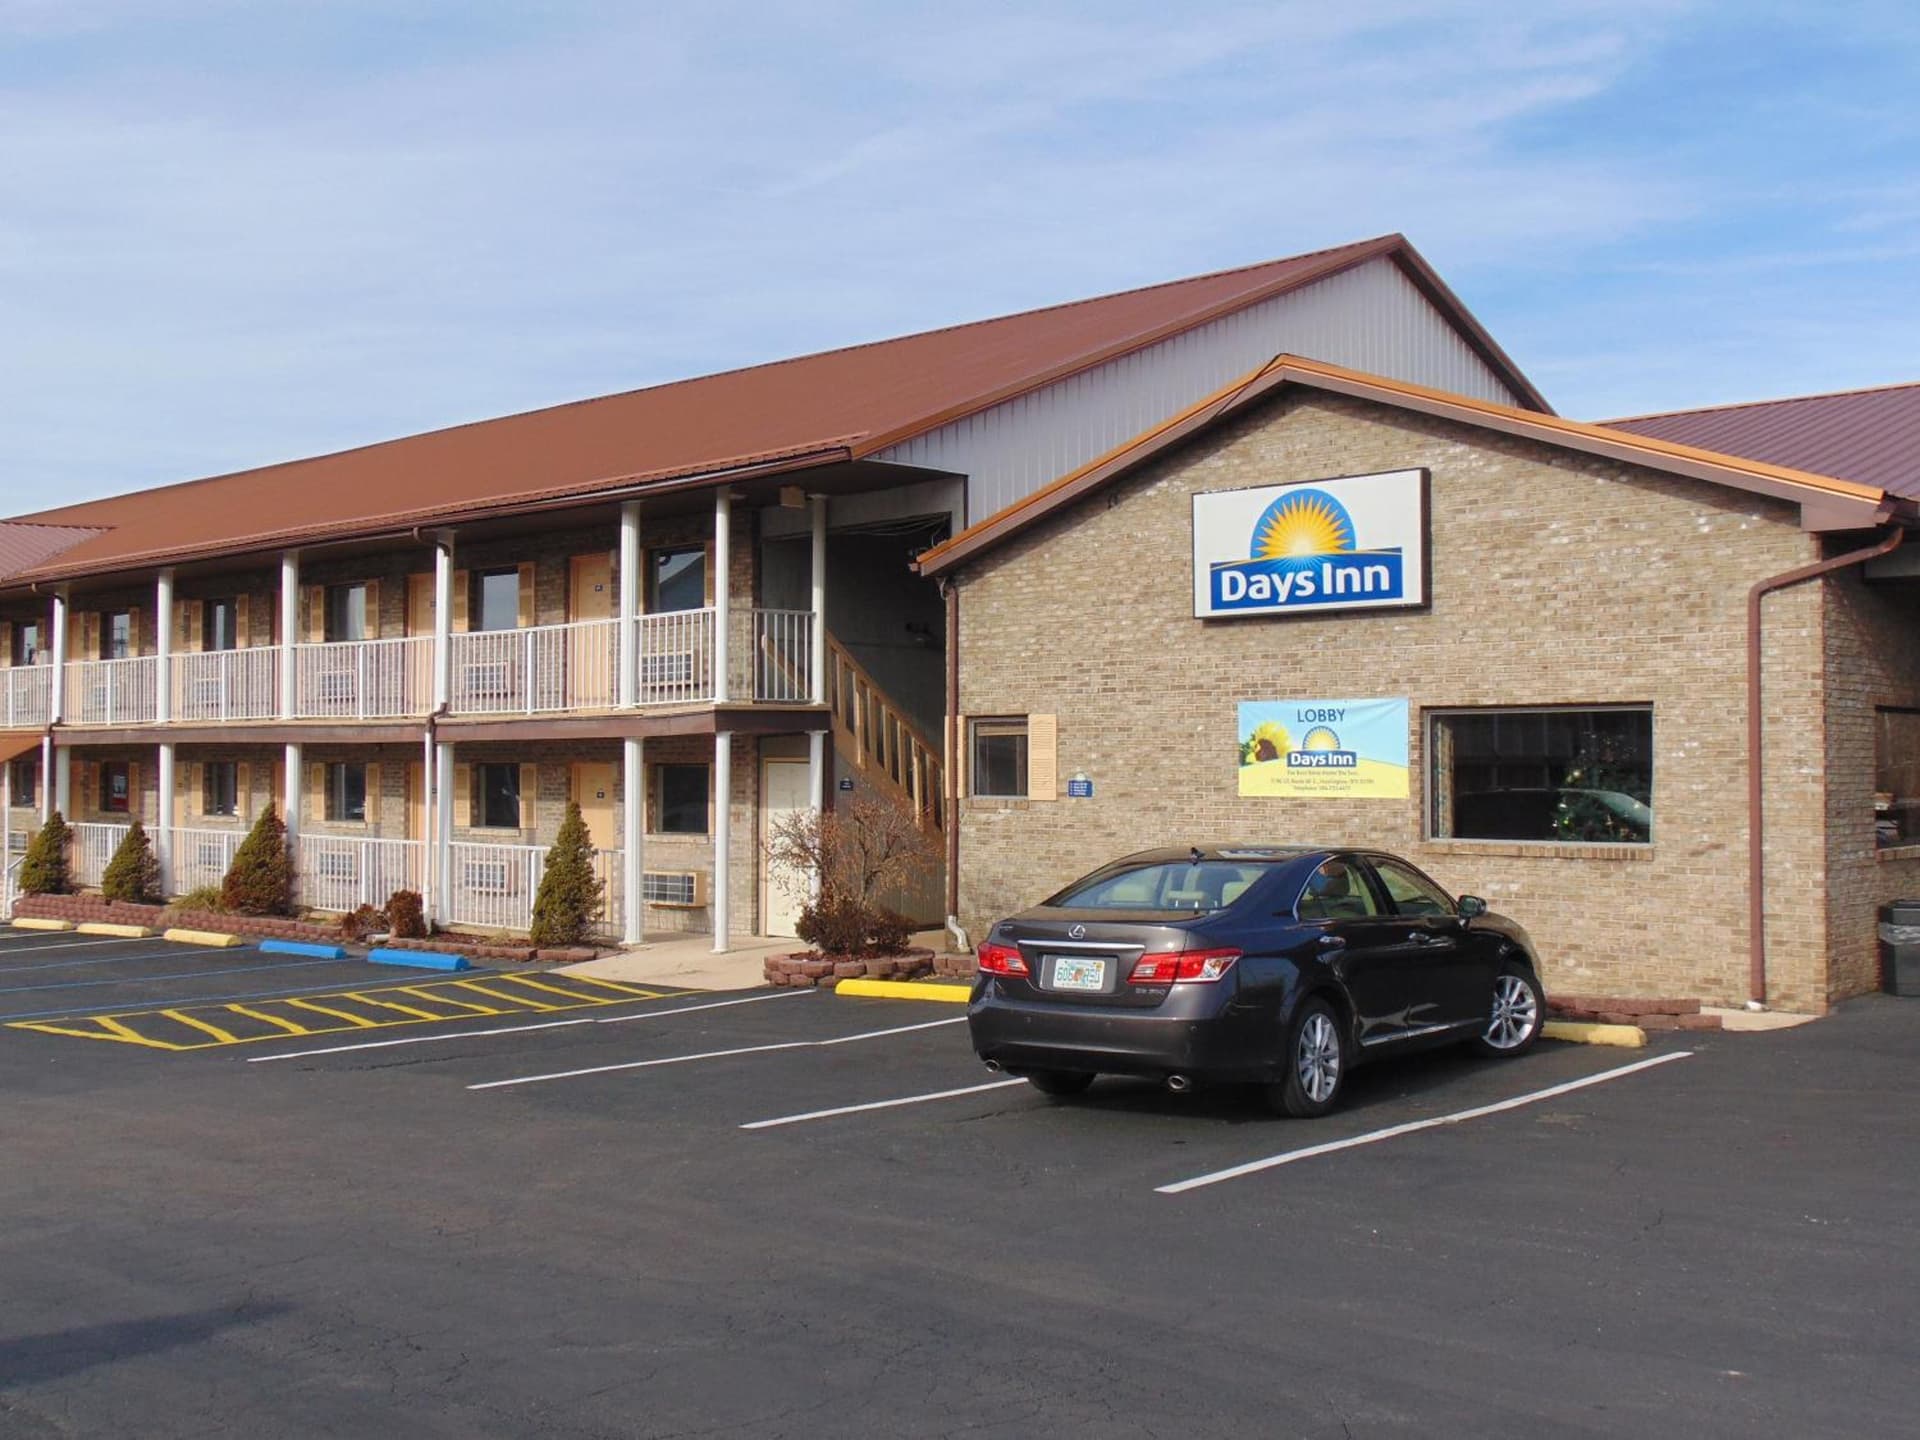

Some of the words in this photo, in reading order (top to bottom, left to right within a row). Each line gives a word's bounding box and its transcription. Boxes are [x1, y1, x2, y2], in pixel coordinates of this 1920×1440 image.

[1221, 569, 1316, 603] Days
[1322, 562, 1390, 595] Inn
[1297, 708, 1346, 723] LOBBY
[1290, 752, 1326, 767] Days
[1328, 753, 1353, 766] Inn
